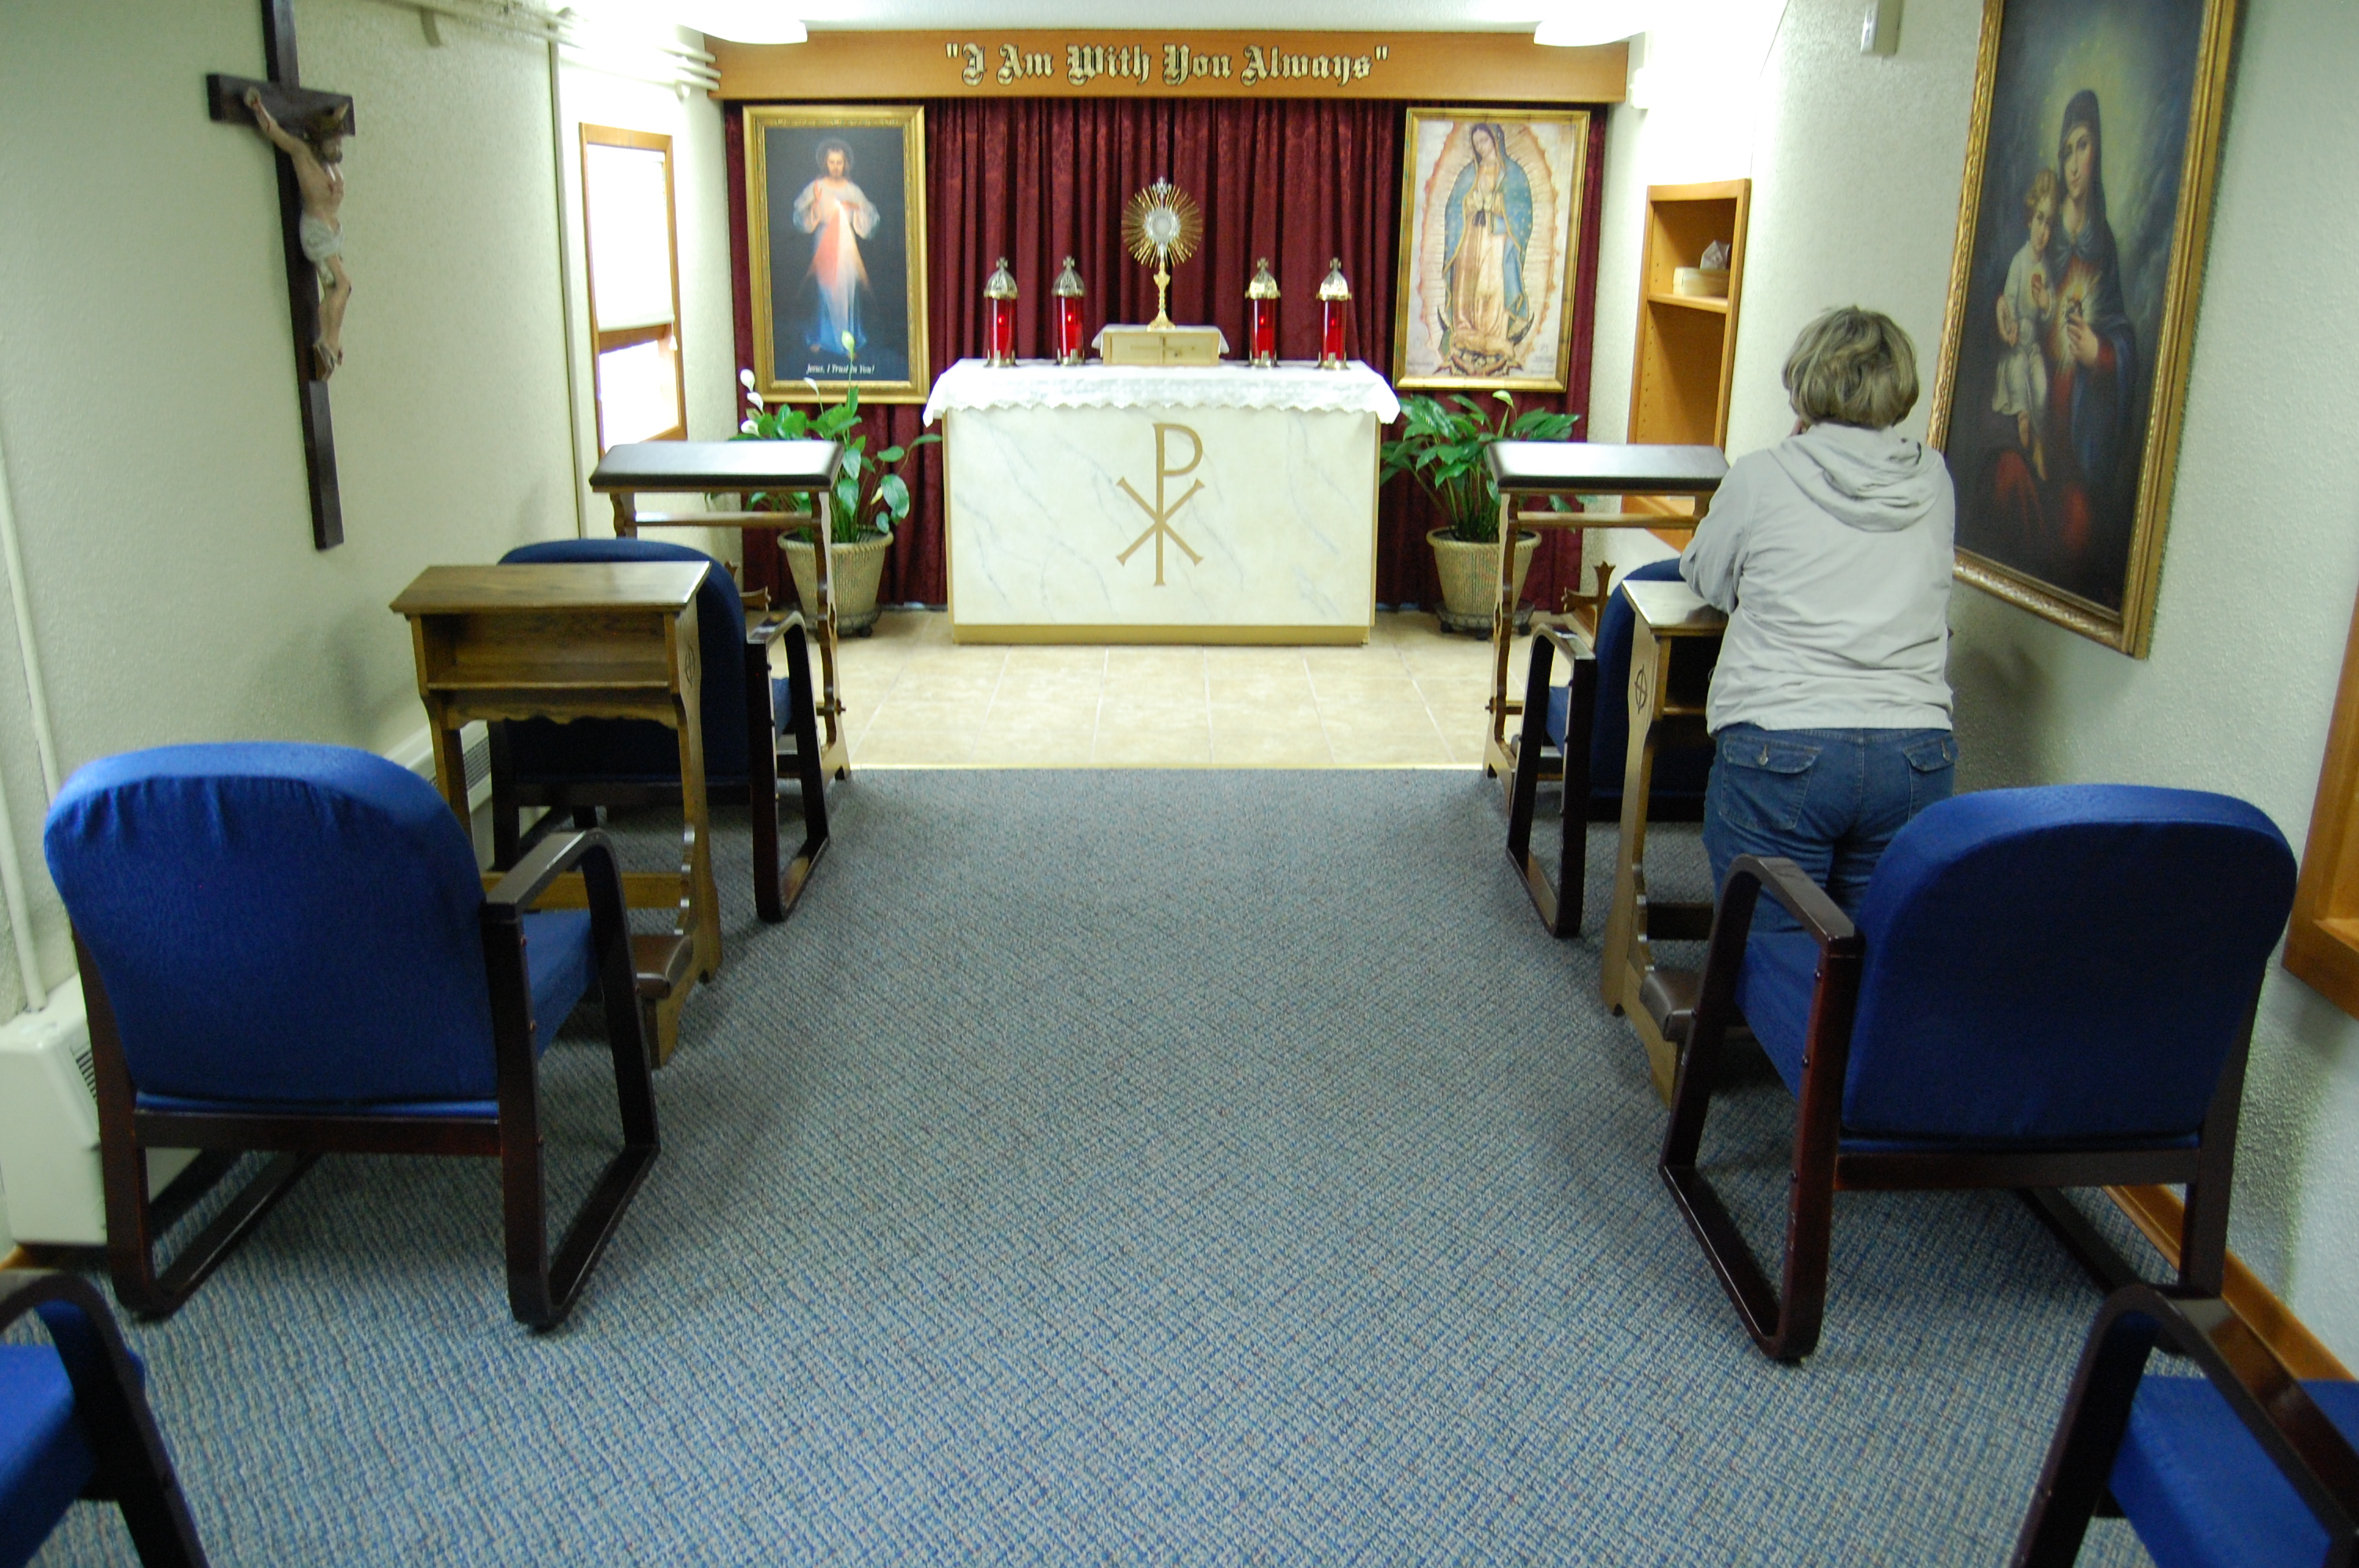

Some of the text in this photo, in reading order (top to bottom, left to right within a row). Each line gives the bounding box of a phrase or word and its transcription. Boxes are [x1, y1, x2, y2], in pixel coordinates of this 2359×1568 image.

[997, 43, 1055, 85] Am
[1067, 43, 1151, 85] With
[1162, 43, 1233, 86] You
[1241, 45, 1389, 87] Always"
